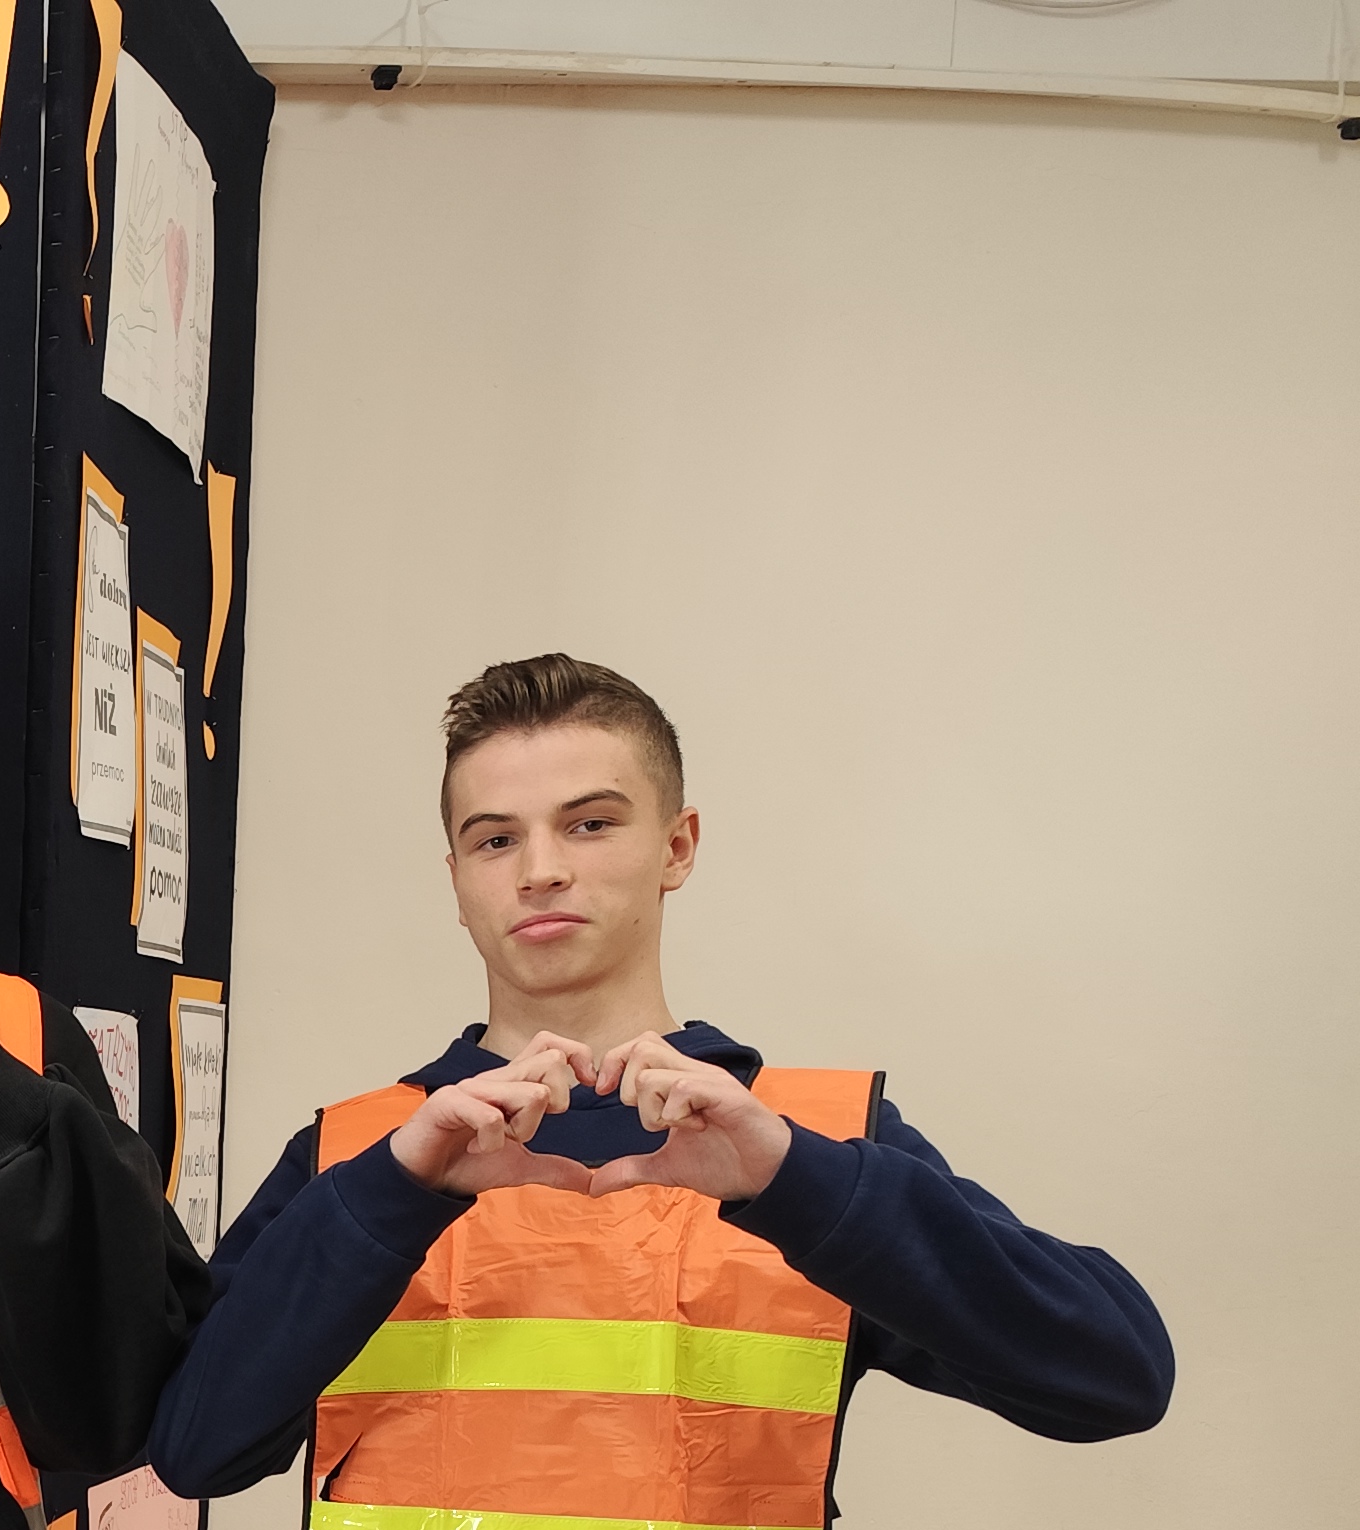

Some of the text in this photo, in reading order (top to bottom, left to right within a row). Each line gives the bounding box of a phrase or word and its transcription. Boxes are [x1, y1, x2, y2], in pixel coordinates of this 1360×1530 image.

[85, 630, 99, 659] JEST
[92, 761, 124, 782] przemoc
[149, 866, 182, 905] pomoc
